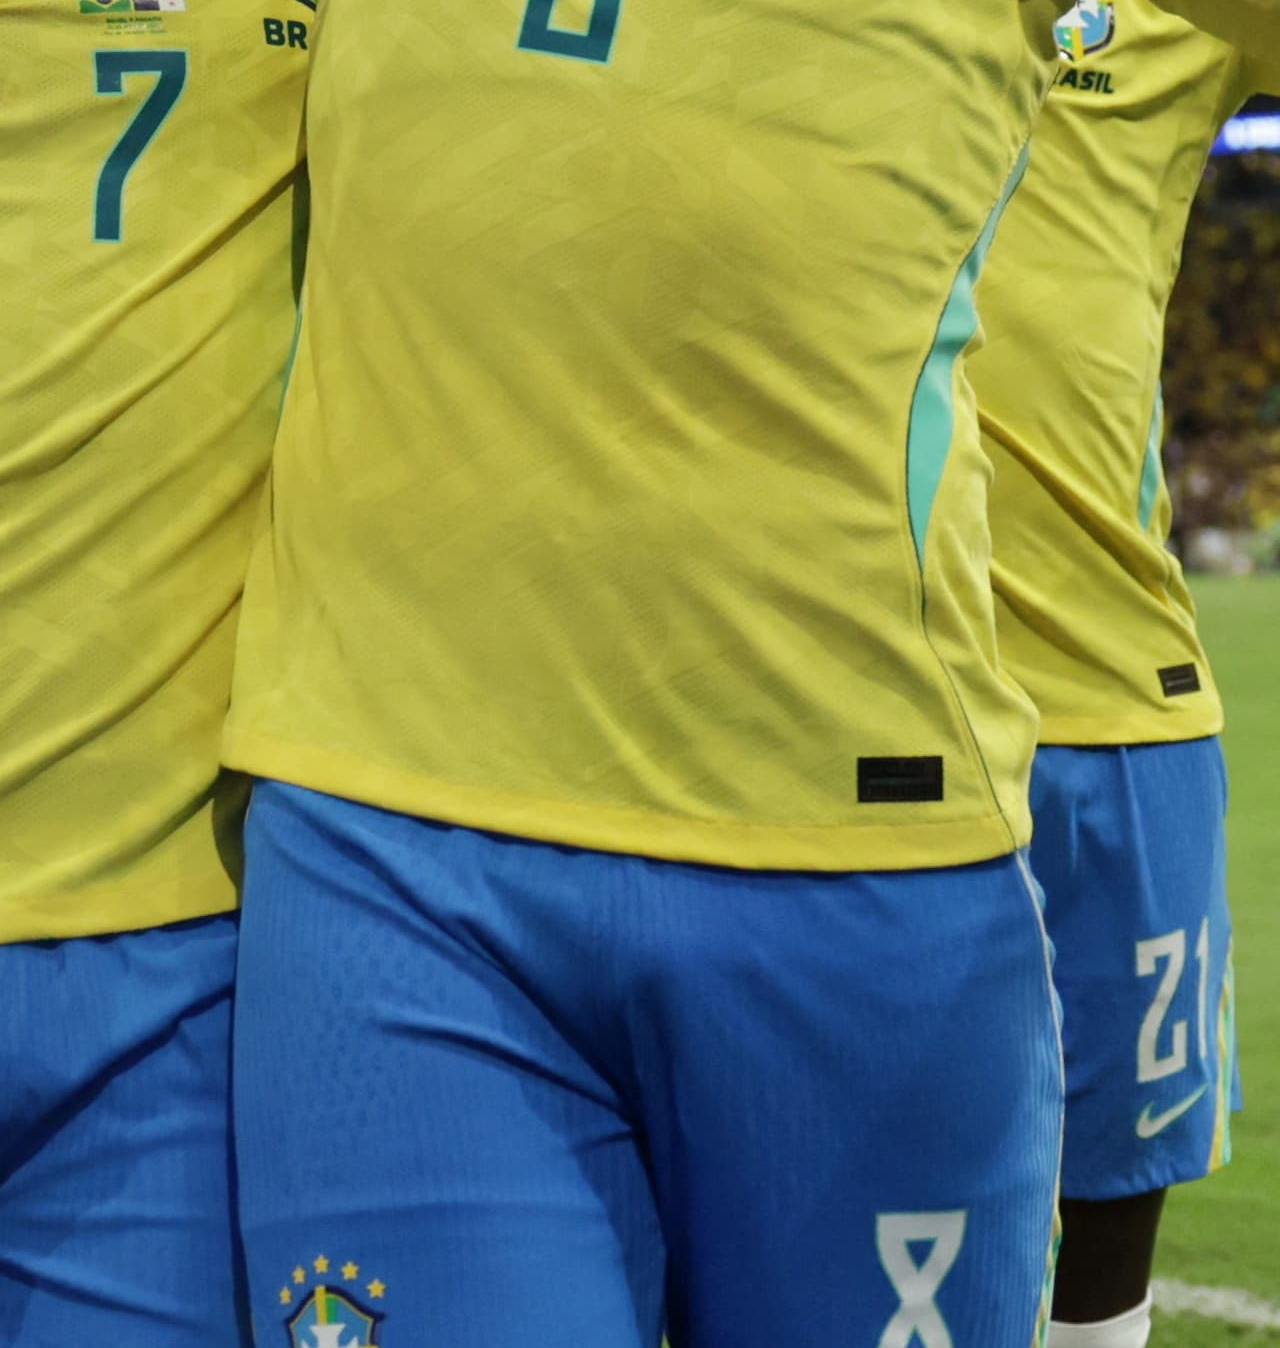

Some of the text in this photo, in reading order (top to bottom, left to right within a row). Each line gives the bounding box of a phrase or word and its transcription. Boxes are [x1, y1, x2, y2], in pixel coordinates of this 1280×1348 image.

[93, 48, 188, 242] 7
[1058, 68, 1114, 94] ASIL
[1135, 916, 1209, 1084] 21
[875, 1209, 969, 1348] 8
